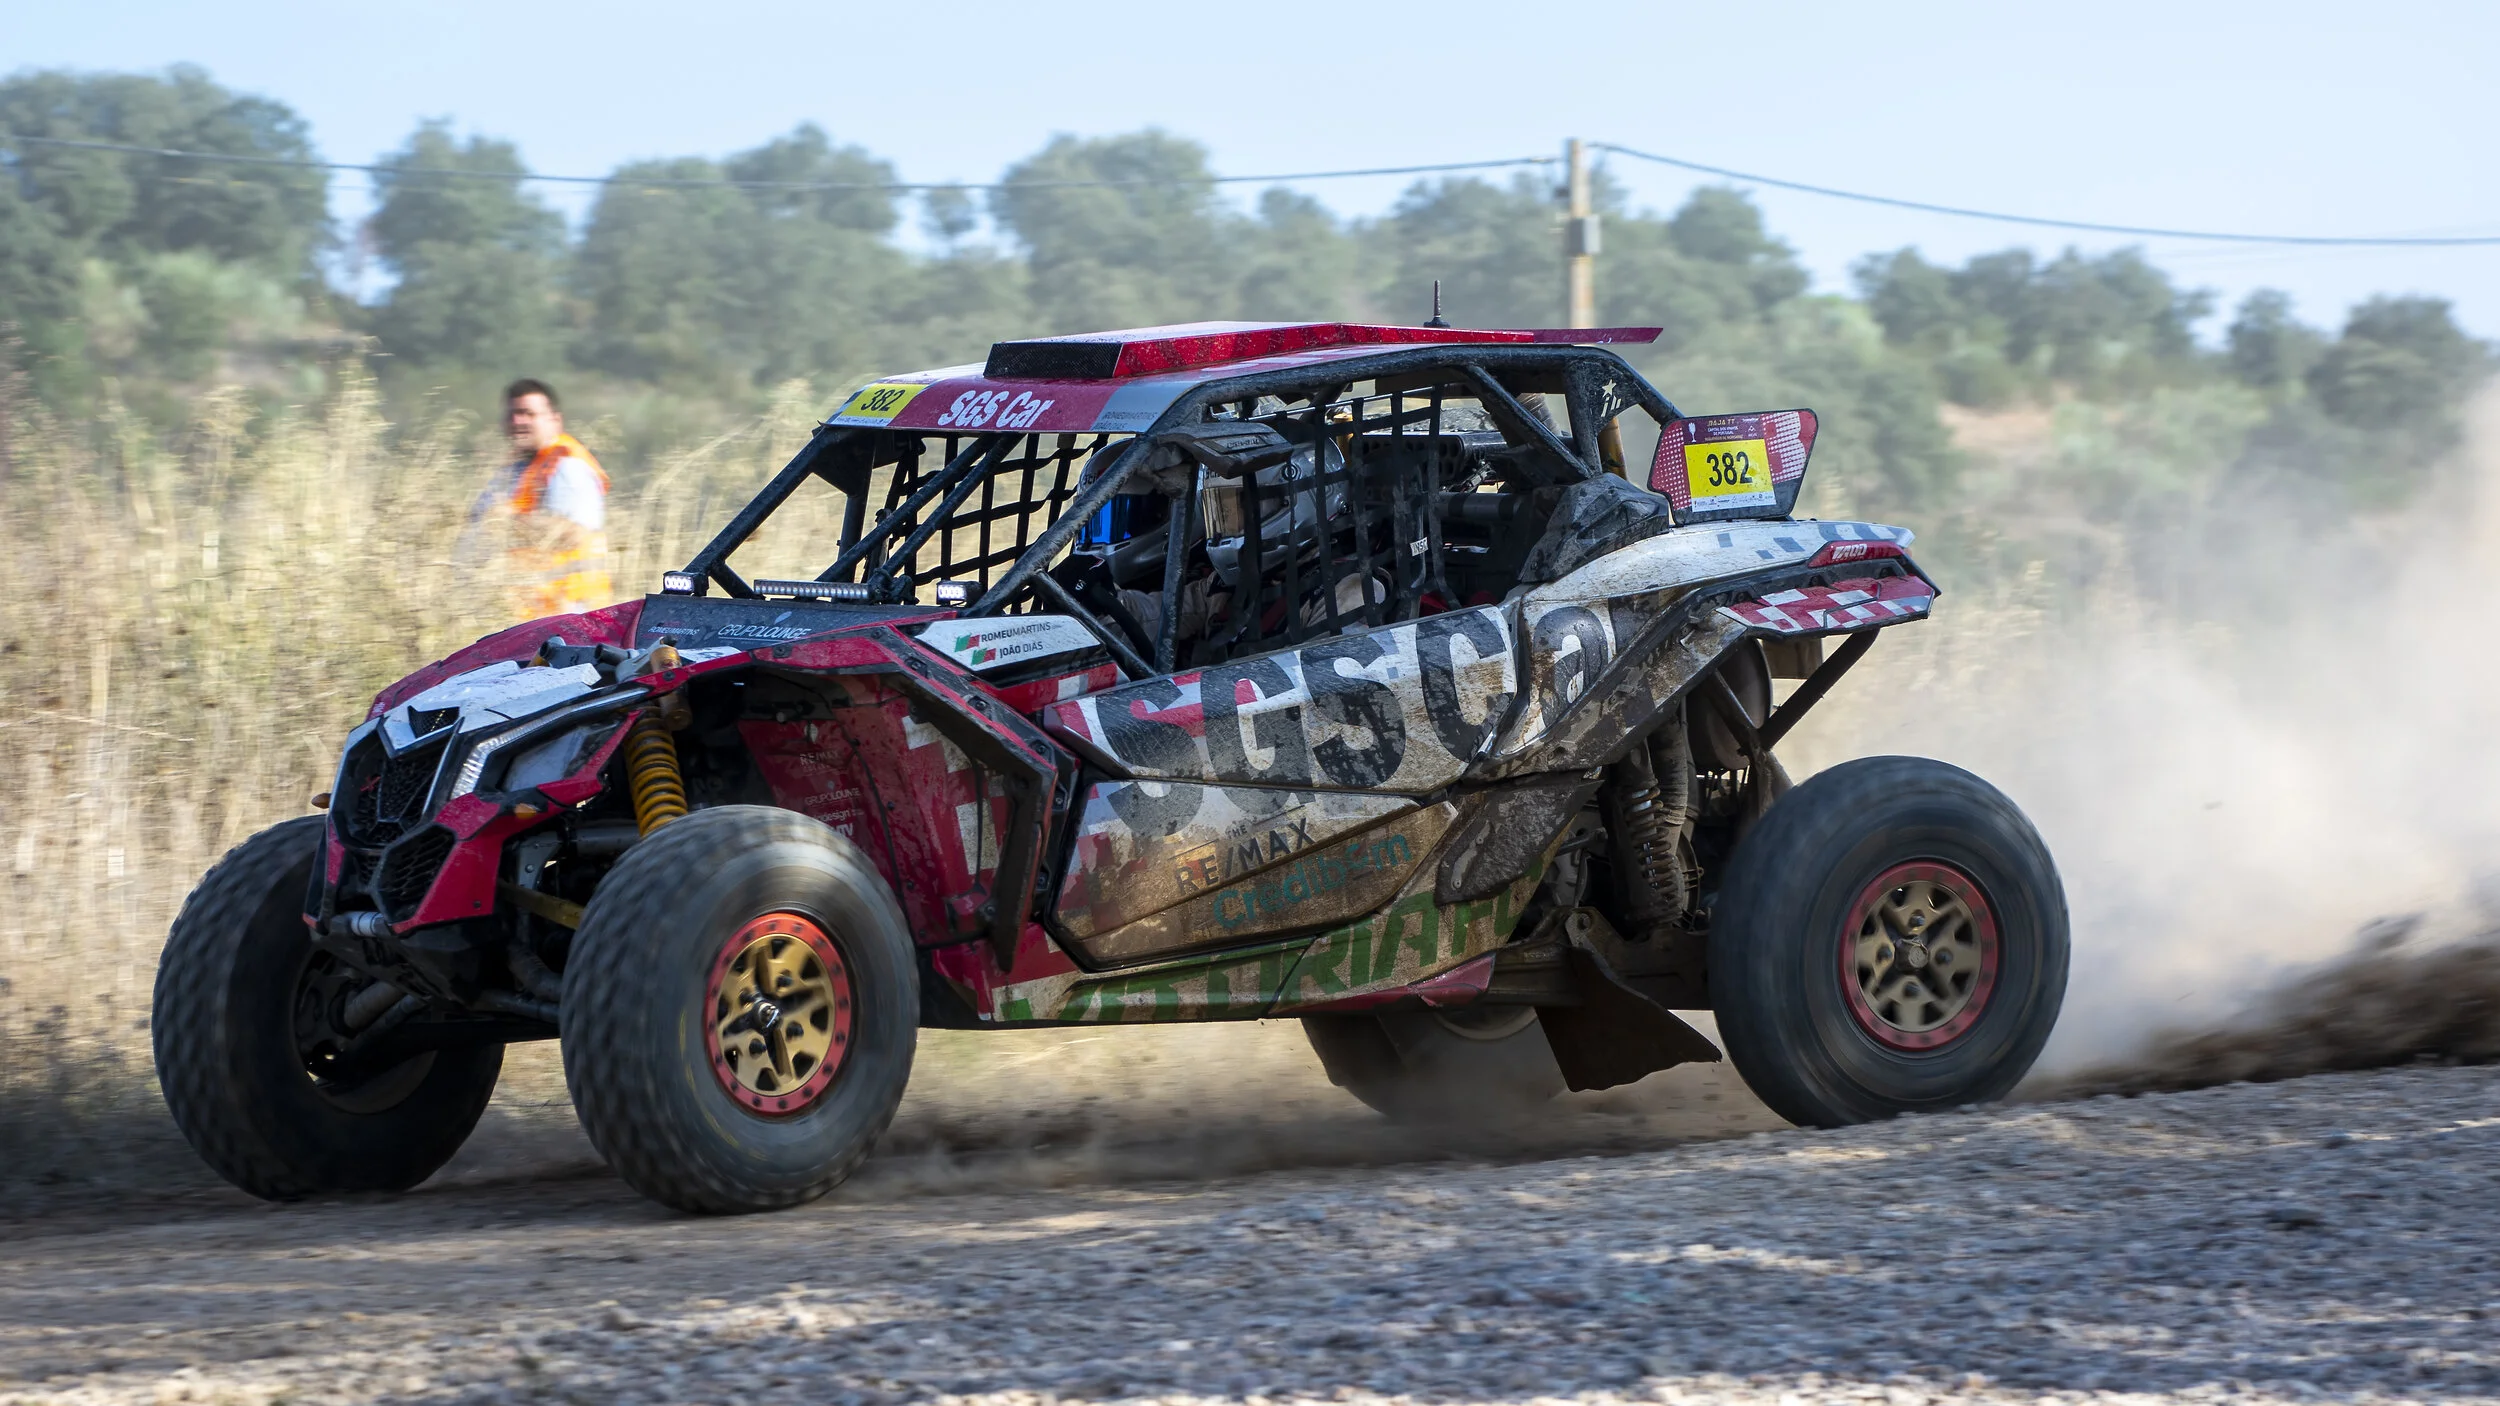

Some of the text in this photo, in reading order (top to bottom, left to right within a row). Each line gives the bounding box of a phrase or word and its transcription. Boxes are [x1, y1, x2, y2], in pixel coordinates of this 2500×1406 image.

[861, 388, 906, 412] 382
[937, 390, 1056, 428] SGS Car
[1706, 451, 1753, 487] 382
[981, 621, 1052, 643] ROMEUMARTINS
[999, 641, 1044, 659] JOÃO DIAS
[1225, 824, 1249, 841] THE
[1174, 816, 1317, 896] RE/MAX
